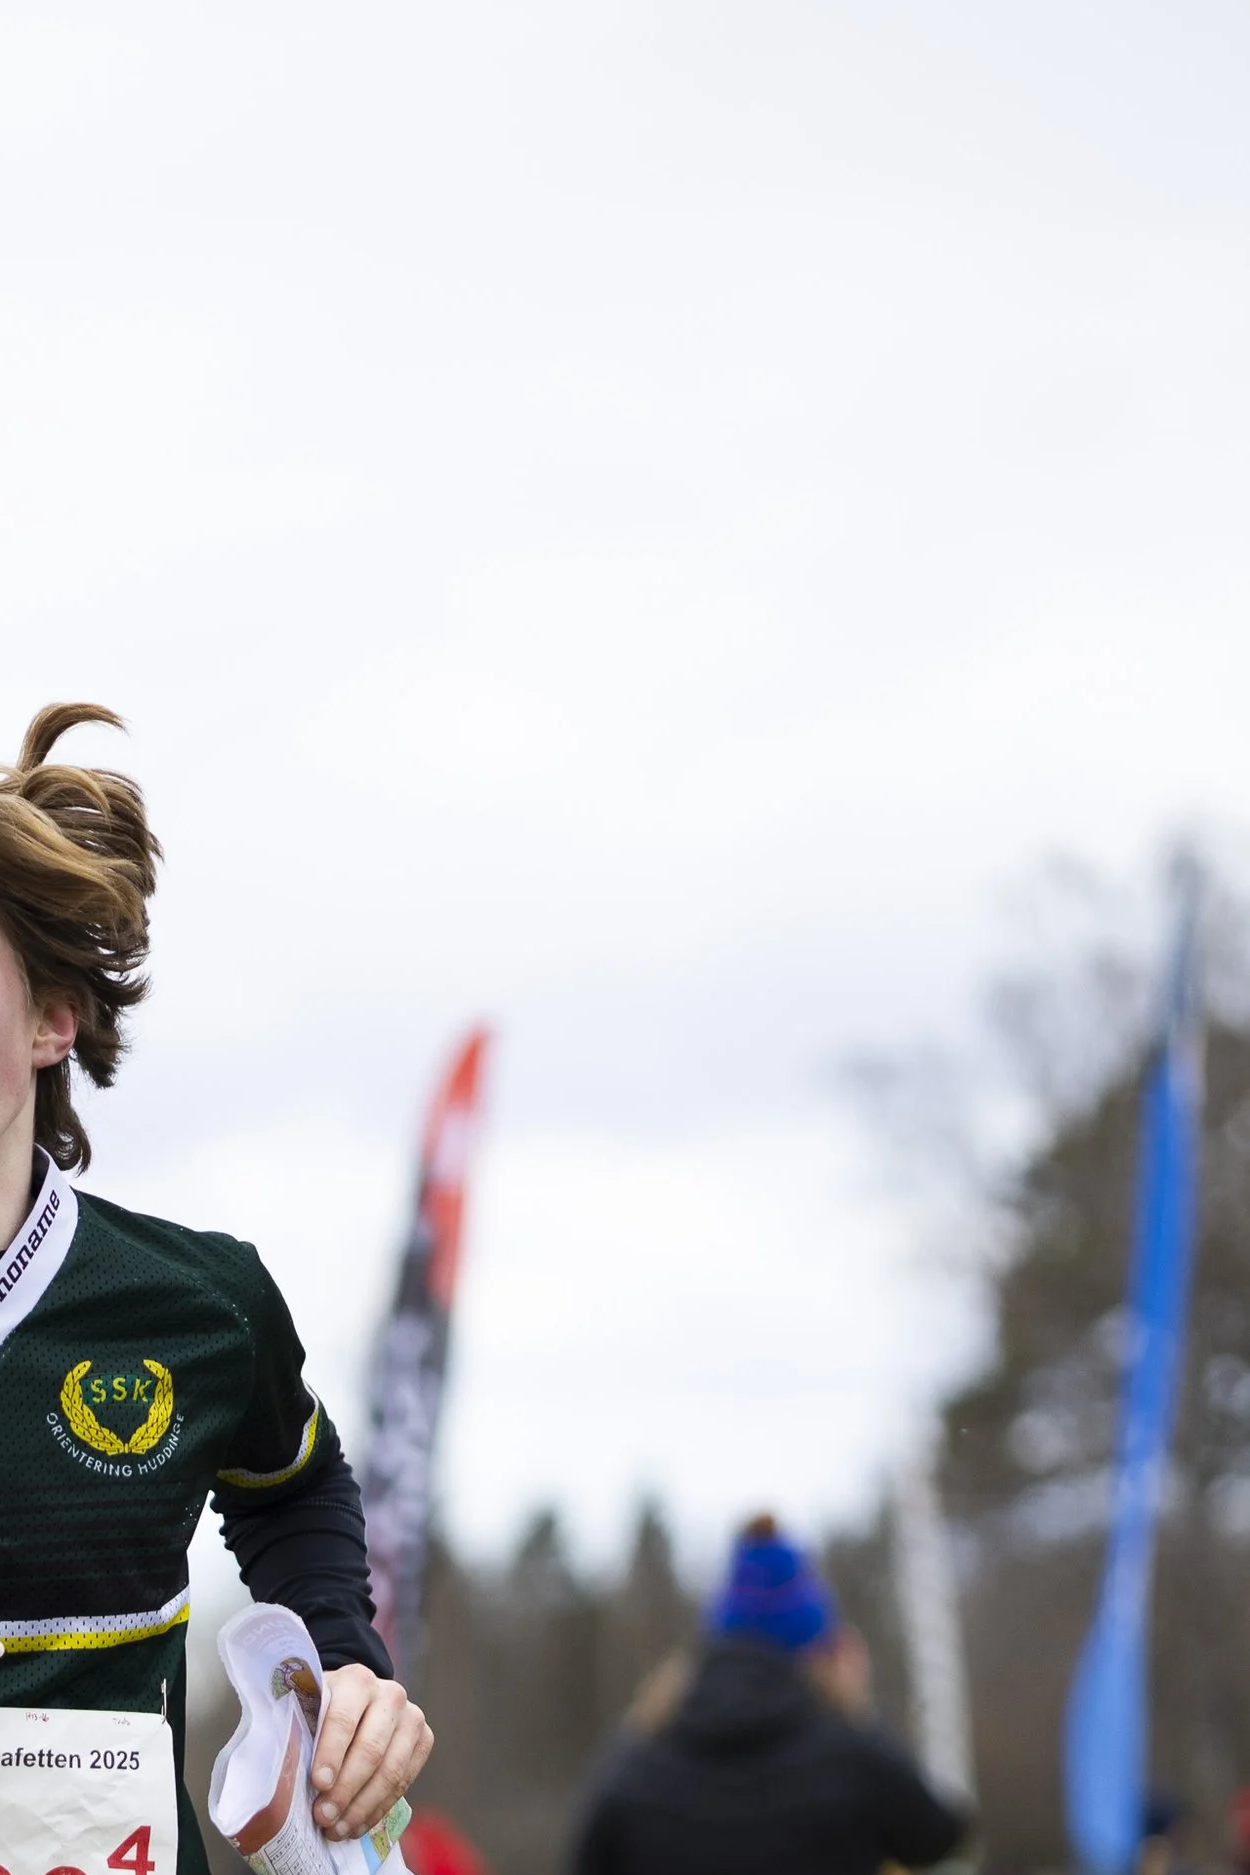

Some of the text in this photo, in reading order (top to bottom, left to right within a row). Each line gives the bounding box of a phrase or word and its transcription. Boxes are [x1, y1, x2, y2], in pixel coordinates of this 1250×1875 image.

[90, 1376, 152, 1403] SSK
[46, 1411, 185, 1477] ORIENTERING HUDDINGE
[89, 1749, 140, 1771] 2025
